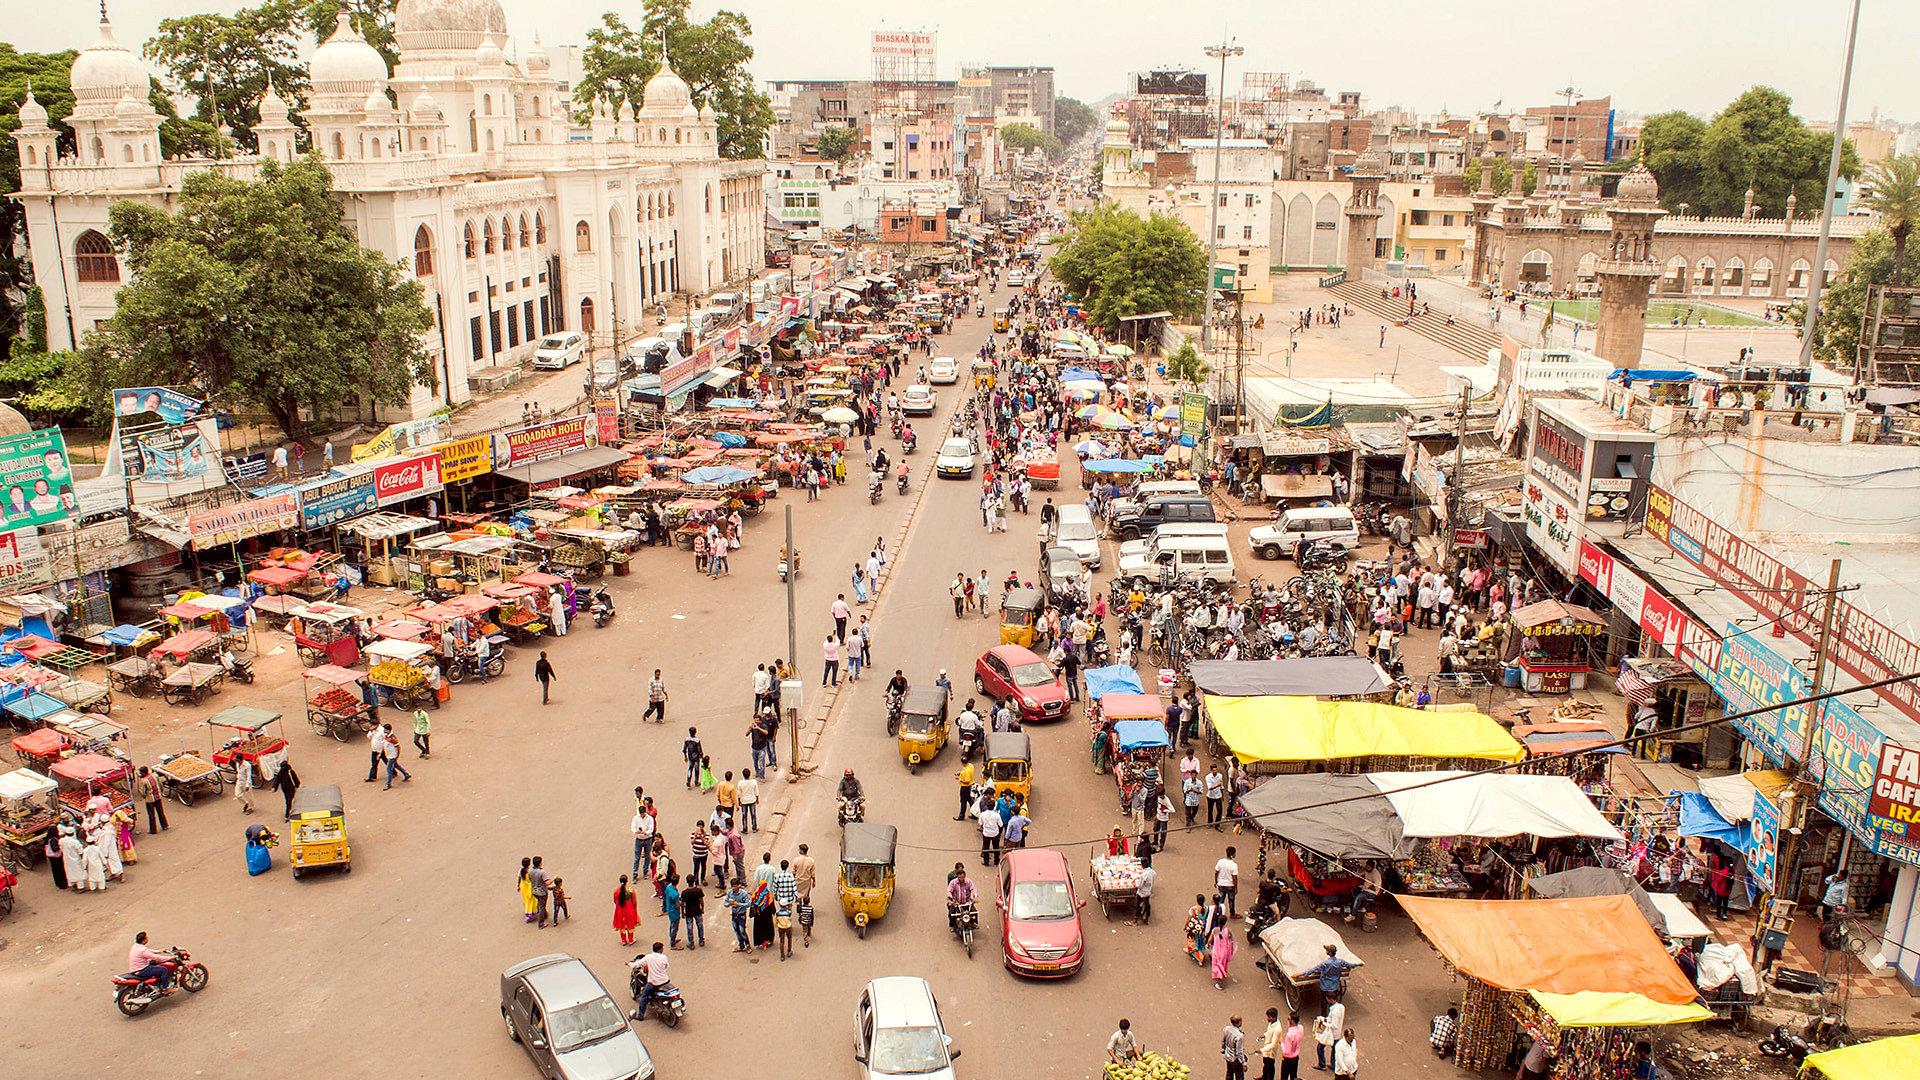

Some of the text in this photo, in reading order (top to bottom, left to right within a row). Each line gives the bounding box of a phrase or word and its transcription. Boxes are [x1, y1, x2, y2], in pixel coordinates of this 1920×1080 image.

[875, 34, 931, 44] BHASKAR ARTS
[510, 427, 557, 445] MUQADDAR
[558, 421, 583, 435] HOTEL
[437, 439, 484, 460] MUNNU
[1537, 422, 1584, 474] NIMRAH
[303, 488, 320, 502] ABUL
[321, 479, 350, 498] BARKAAT
[349, 471, 375, 490] BAKERY
[196, 502, 289, 531] SADDAM HOTEL
[1670, 498, 1709, 547] FARASHA
[1706, 521, 1731, 561] CAFE
[1727, 540, 1737, 567] &
[1736, 540, 1780, 590] BAKERY
[18, 571, 36, 580] POINT
[1728, 640, 1783, 691] SHAADAN
[1719, 652, 1784, 714] PEARLS
[1892, 681, 1913, 706] IRANI
[1726, 702, 1783, 756] PARLS
[1872, 815, 1904, 834] VEG
